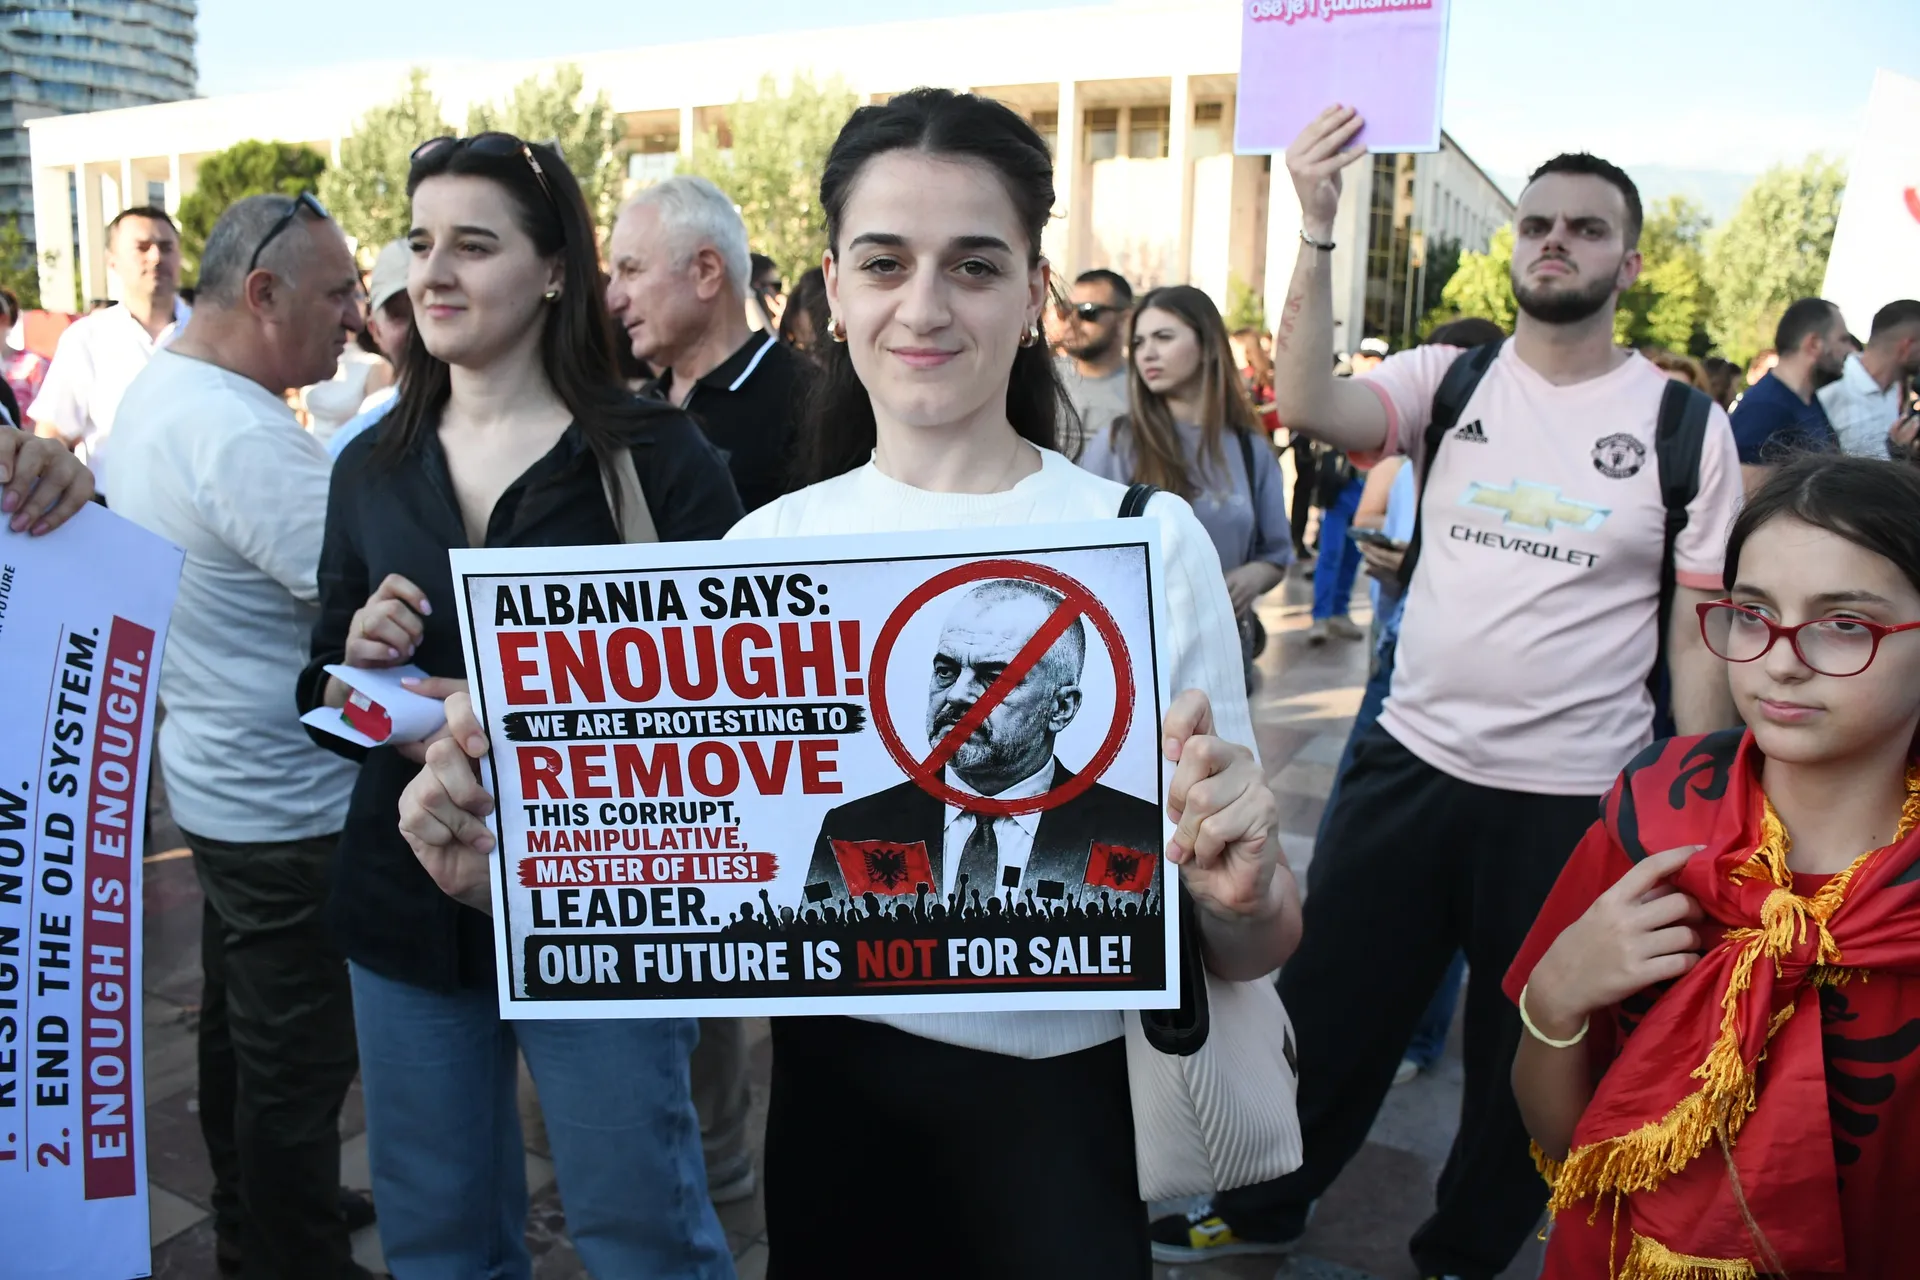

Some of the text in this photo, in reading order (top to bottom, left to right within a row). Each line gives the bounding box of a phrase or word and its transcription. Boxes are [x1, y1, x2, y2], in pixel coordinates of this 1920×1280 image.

[1250, 2, 1283, 19] ose
[1450, 524, 1600, 569] CHEVROLET
[495, 573, 830, 626] ALBANIA SAYS:
[496, 620, 864, 705] ENOUGH!
[525, 707, 847, 737] WE ARE PROTESTING TO
[516, 739, 843, 800] REMOVE
[523, 801, 741, 827] THIS CORRUPT,
[0, 781, 29, 905] NOW.
[526, 827, 748, 852] MANIPULATIVE,
[535, 855, 758, 883] MASTER OF LIES!
[37, 627, 99, 1167] 2. END THE OLD SYSTEM.
[90, 649, 146, 1159] ENOUGH IS ENOUGH.
[531, 886, 720, 929] LEADER.
[538, 935, 1132, 984] OUR FUTURE IS NOT FOR SALE!
